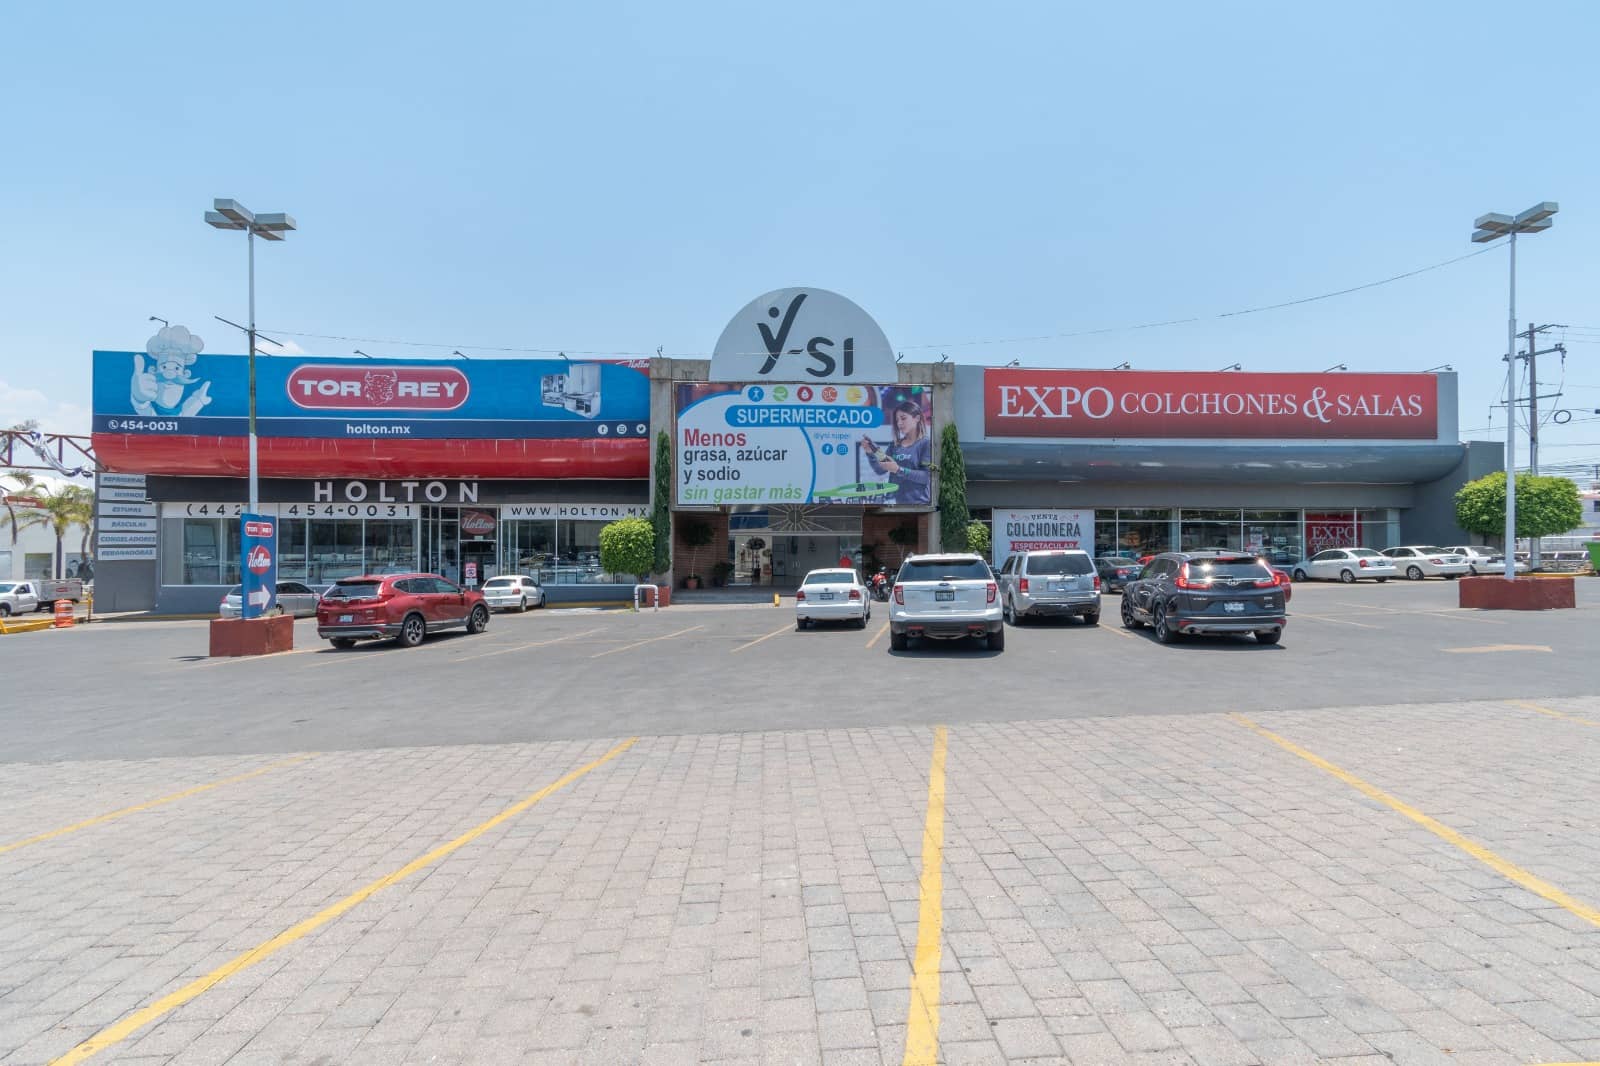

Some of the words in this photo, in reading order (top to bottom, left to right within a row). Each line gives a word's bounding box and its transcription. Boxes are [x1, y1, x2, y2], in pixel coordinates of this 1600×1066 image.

[298, 380, 361, 397] TOR
[398, 382, 459, 398] REY
[998, 385, 1114, 419] EXPO
[1120, 392, 1298, 415] COLCHONES
[1302, 386, 1333, 423] &
[1337, 394, 1423, 417] SALAS
[737, 408, 873, 425] SUPERMERCADO
[120, 420, 178, 431] 454-0031
[346, 423, 410, 434] holton.mx
[684, 428, 747, 447] Menos
[684, 449, 731, 465] grasa,
[736, 446, 788, 461] azúcar
[683, 468, 693, 485] y
[697, 466, 741, 481] sodio
[314, 481, 479, 503] HOLTON
[684, 485, 709, 500] sin
[713, 486, 765, 503] gastar
[768, 483, 803, 499] más
[289, 504, 411, 517] 454-0031
[511, 506, 648, 517] WWW.HOLTON.MX
[1006, 522, 1081, 537] COLCHONERA
[1014, 541, 1074, 550] ESPECTACULAR
